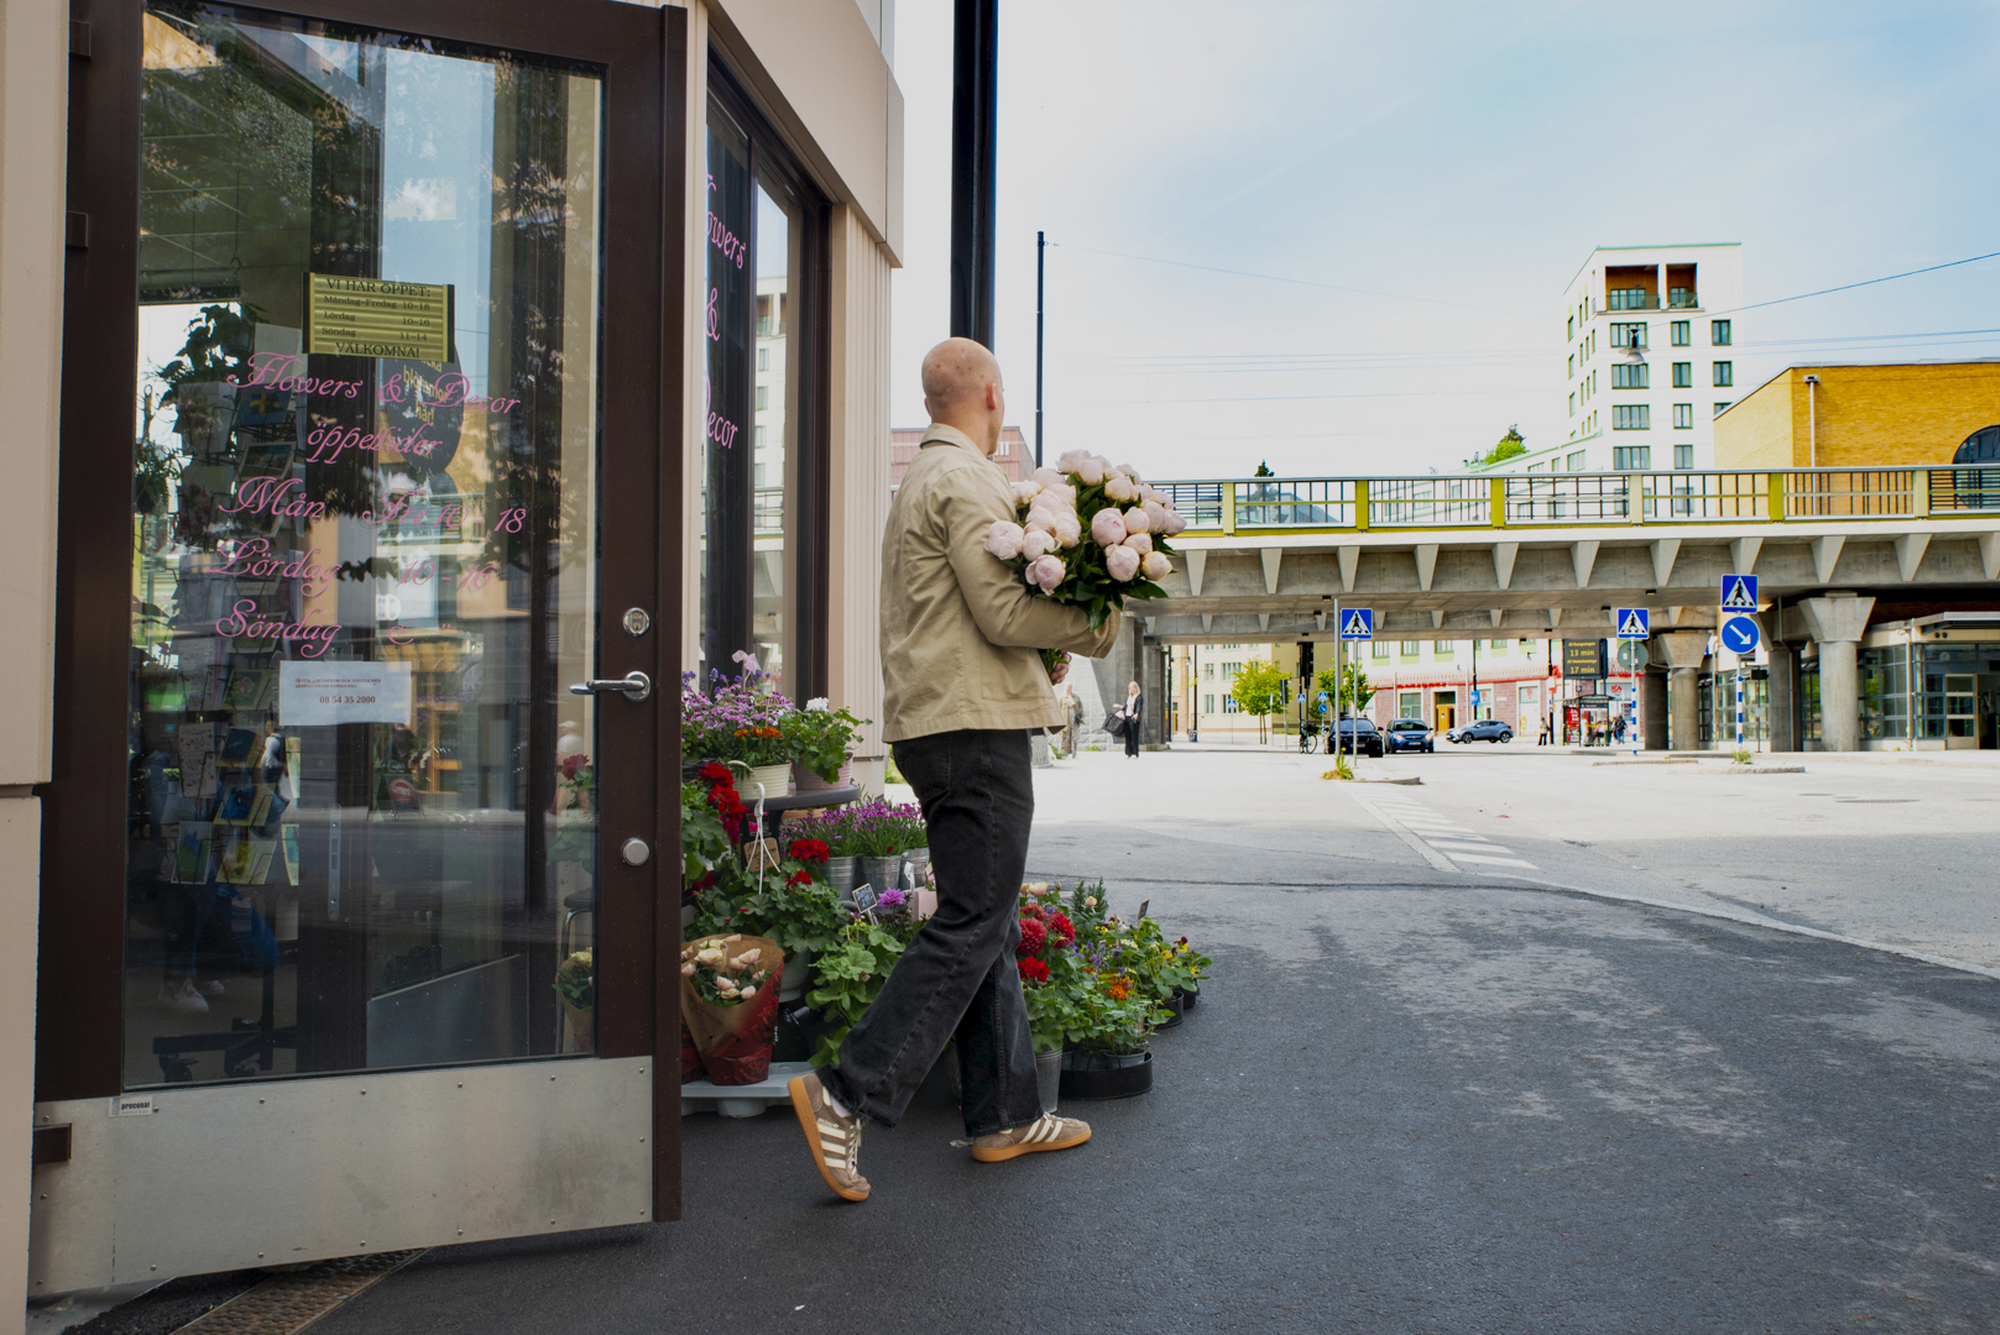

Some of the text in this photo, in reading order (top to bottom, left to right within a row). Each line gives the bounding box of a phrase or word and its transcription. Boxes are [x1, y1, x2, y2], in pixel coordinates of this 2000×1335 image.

[326, 279, 431, 297] VI HAR ÖPPET:
[402, 301, 430, 311] 10-18
[323, 311, 430, 327] Lördag 10-16
[321, 327, 427, 341] Söndag 11-14
[335, 342, 420, 358] VÄLKOMNA!
[226, 351, 521, 414] Flowers & Decor
[306, 423, 443, 464] öppettider
[218, 476, 325, 519] Mån
[361, 488, 430, 525] Fre
[433, 503, 472, 528] 10
[494, 508, 527, 534] 18
[205, 538, 343, 597] Lördag
[399, 560, 438, 586] 10
[461, 561, 498, 590] 16
[215, 599, 343, 658] Söndag
[1570, 666, 1595, 674] 17 min
[319, 695, 376, 704] 08 54 35 2000
